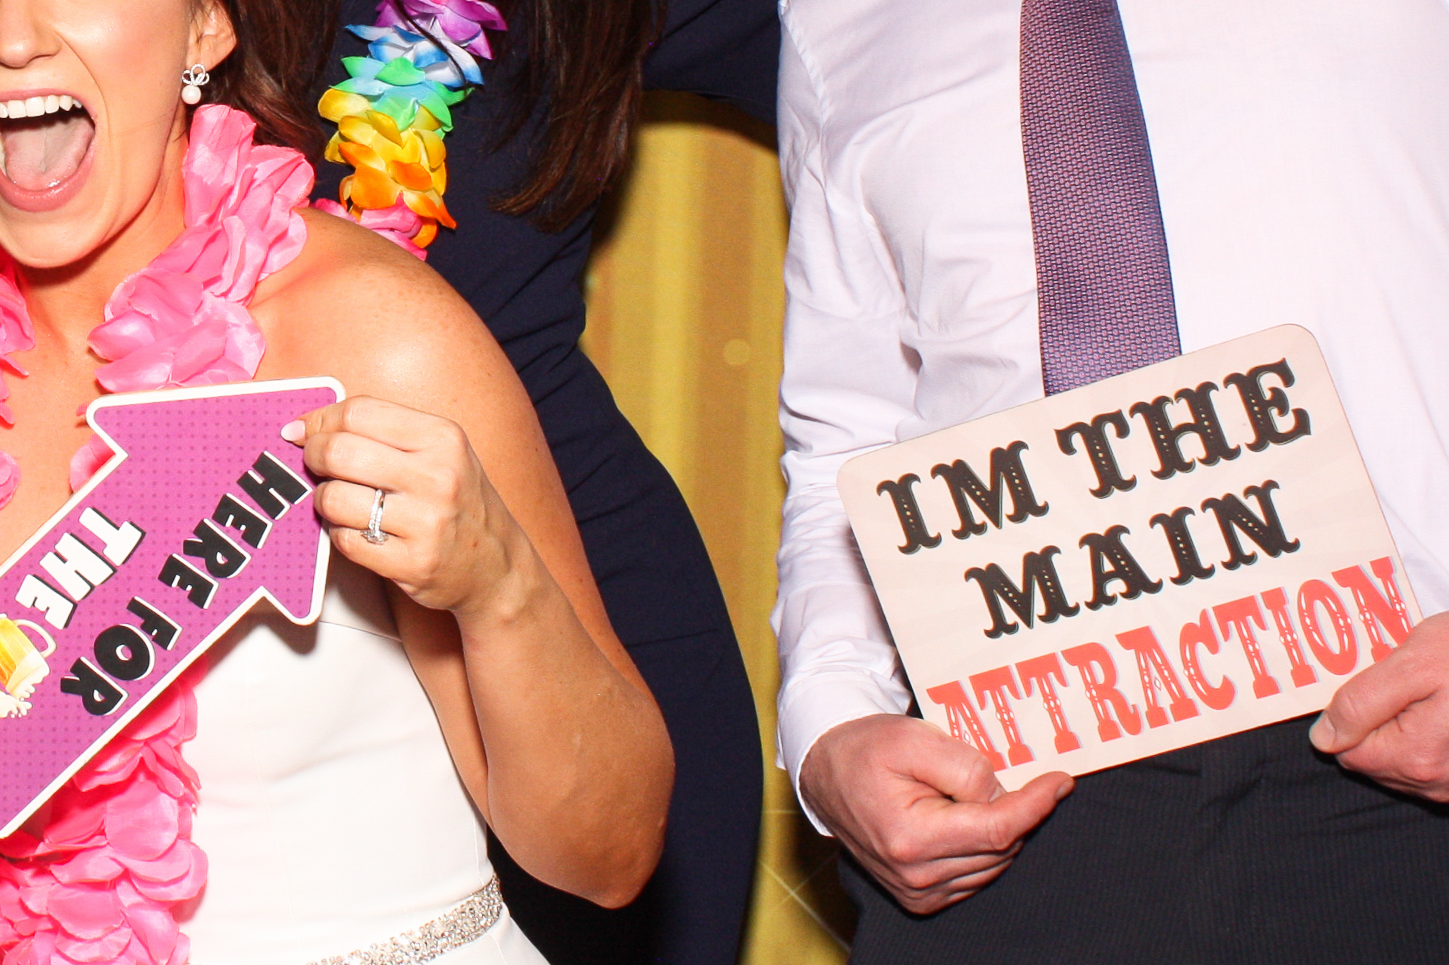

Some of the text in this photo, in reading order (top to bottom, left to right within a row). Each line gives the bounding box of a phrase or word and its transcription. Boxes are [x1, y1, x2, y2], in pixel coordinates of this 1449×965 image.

[158, 450, 313, 609] HERE
[876, 357, 1312, 555] IM THE
[15, 507, 147, 630] THE
[964, 479, 1301, 639] MAIN
[60, 596, 183, 716] FOR
[926, 555, 1413, 772] ATTRACTION
